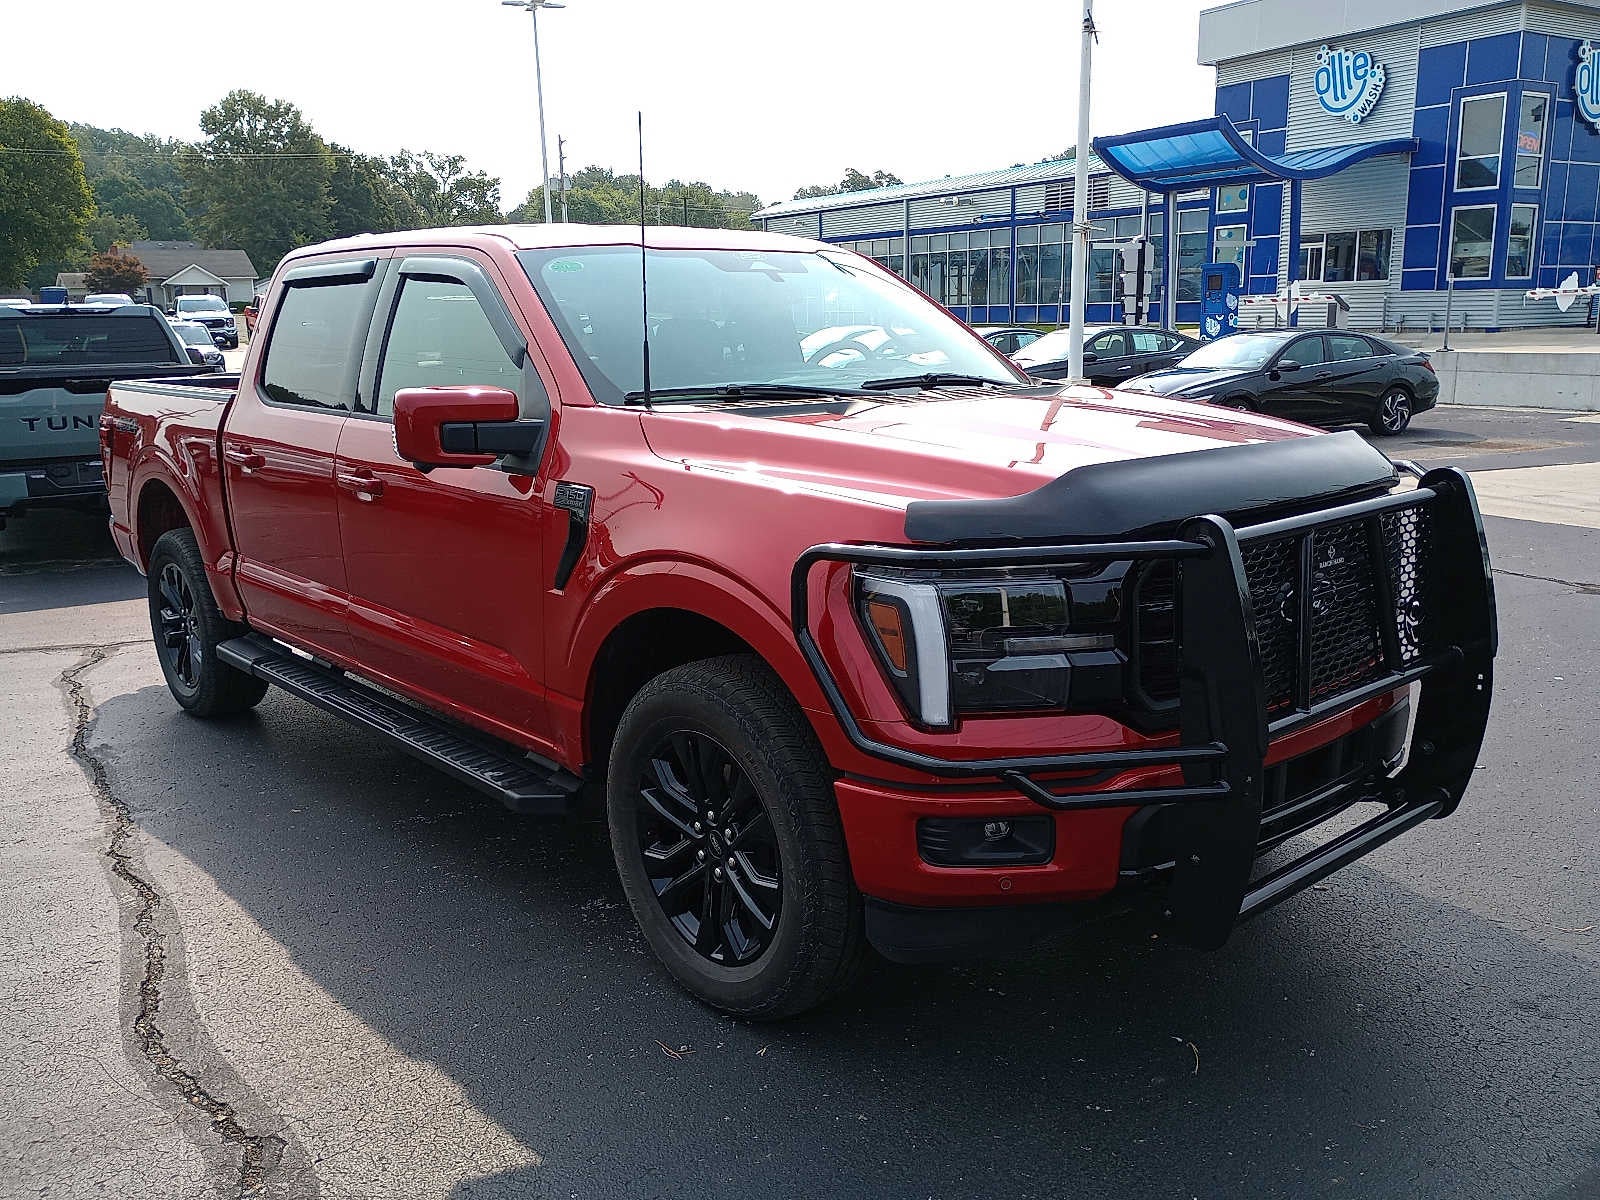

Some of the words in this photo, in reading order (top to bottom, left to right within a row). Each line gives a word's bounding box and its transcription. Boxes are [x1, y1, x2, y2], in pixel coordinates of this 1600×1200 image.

[1315, 52, 1369, 102] ollie
[1357, 83, 1382, 115] WASH
[1518, 133, 1539, 152] OPEN
[19, 415, 100, 432] TUN
[555, 486, 584, 501] F-150
